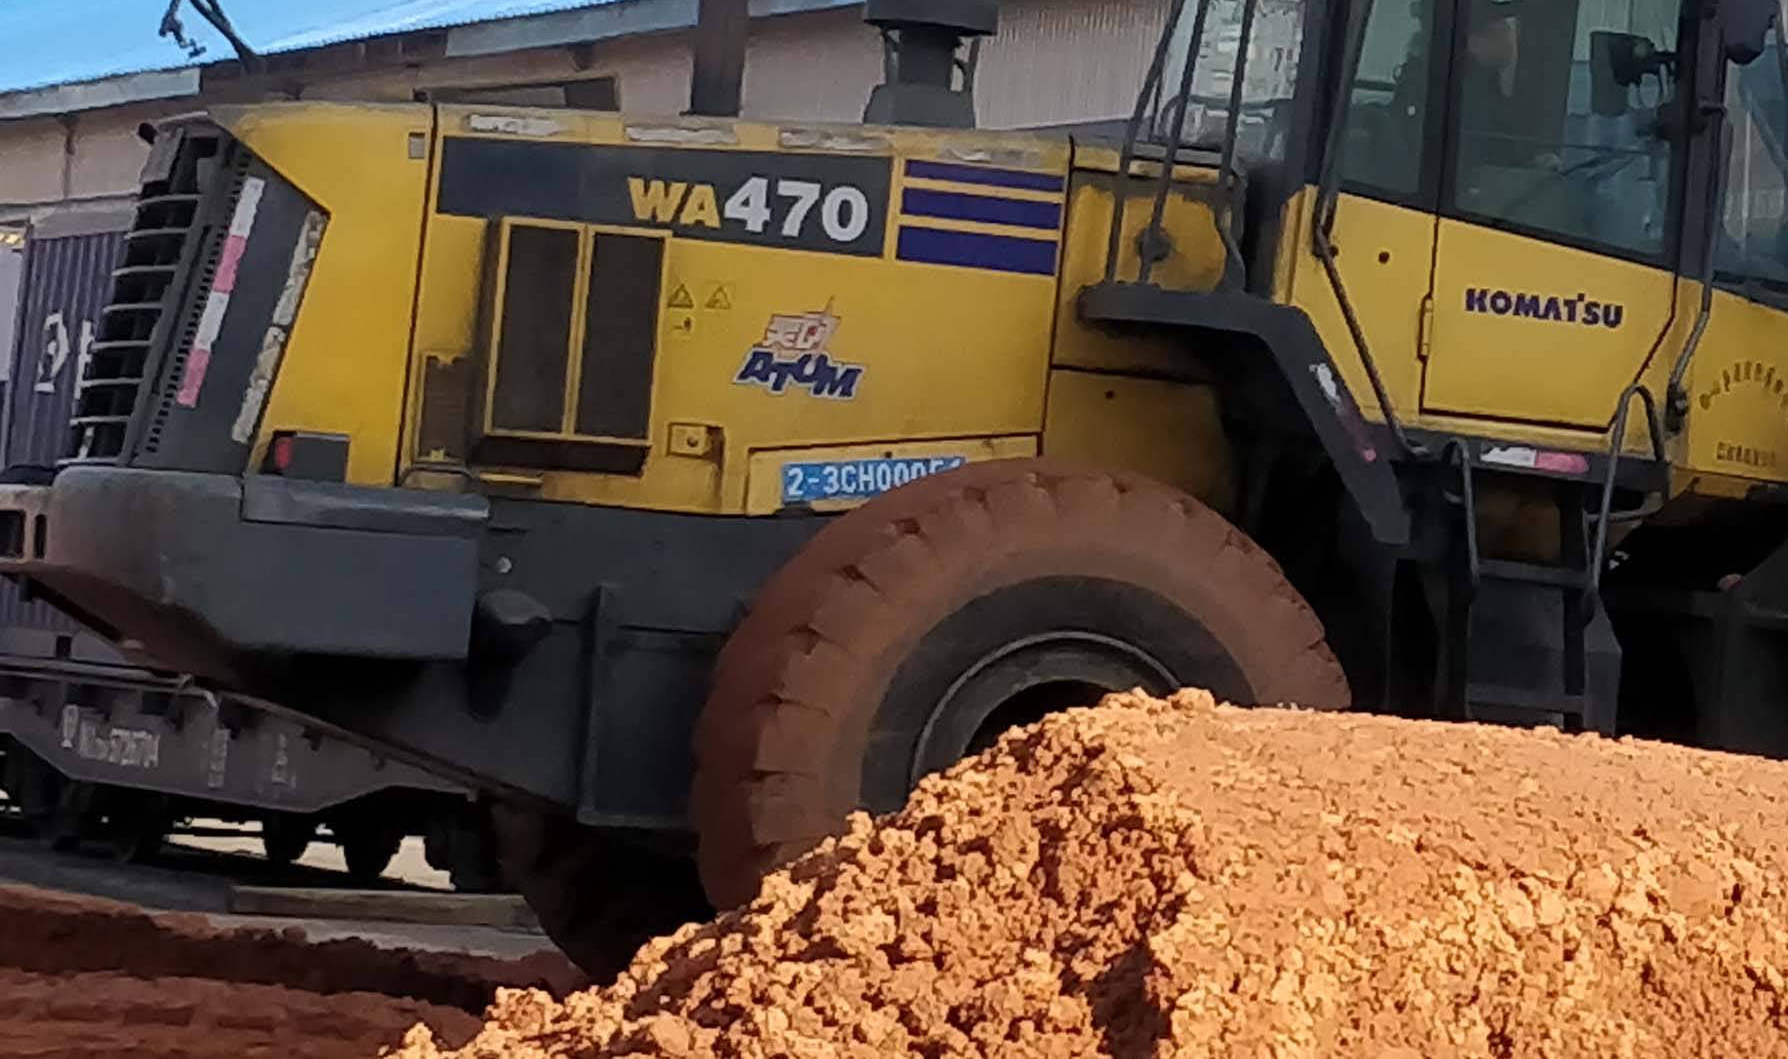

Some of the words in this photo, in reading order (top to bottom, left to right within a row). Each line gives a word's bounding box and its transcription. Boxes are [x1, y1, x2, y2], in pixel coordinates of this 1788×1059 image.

[627, 176, 869, 242] WA470
[1465, 288, 1624, 328] KOMATSU
[787, 457, 962, 497] 2-3CH000
